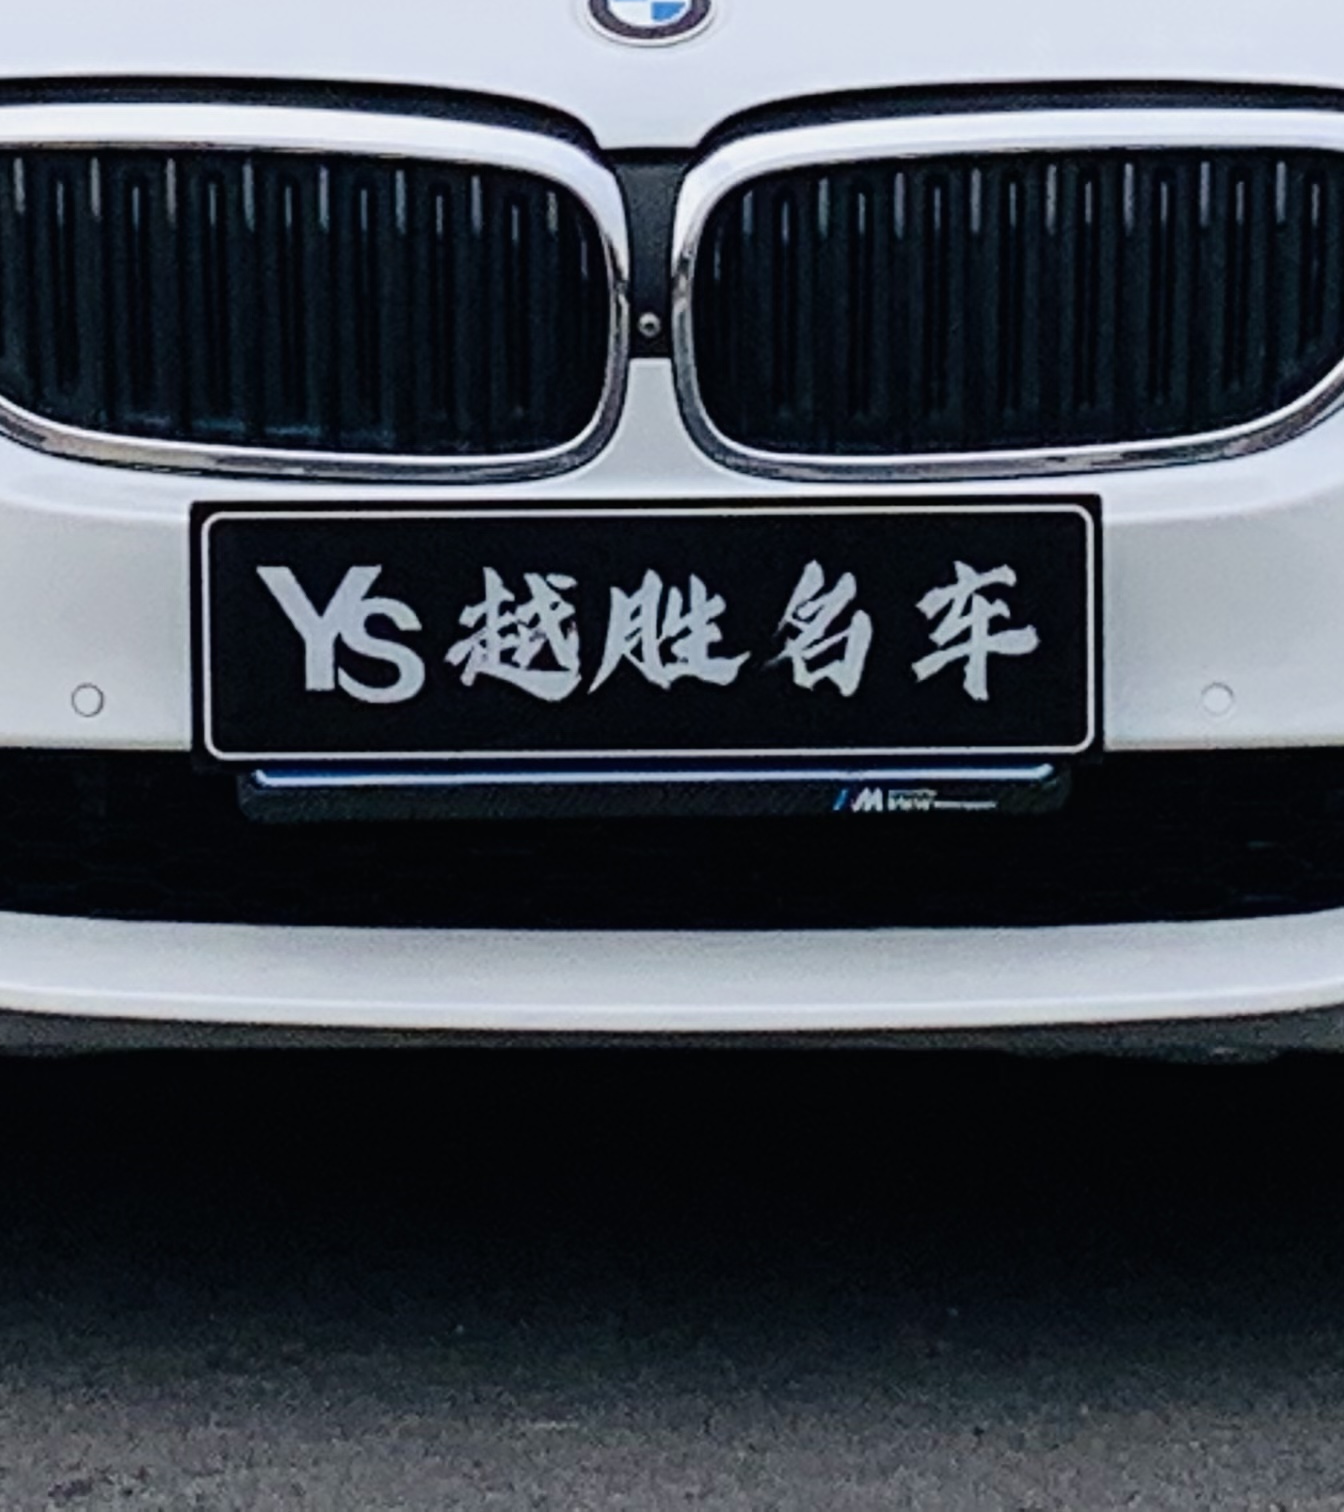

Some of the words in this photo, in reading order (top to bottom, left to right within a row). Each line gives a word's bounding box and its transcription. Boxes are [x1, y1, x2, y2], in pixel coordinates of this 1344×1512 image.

[256, 563, 425, 703] YS
[444, 559, 1039, 702] 越胜名车
